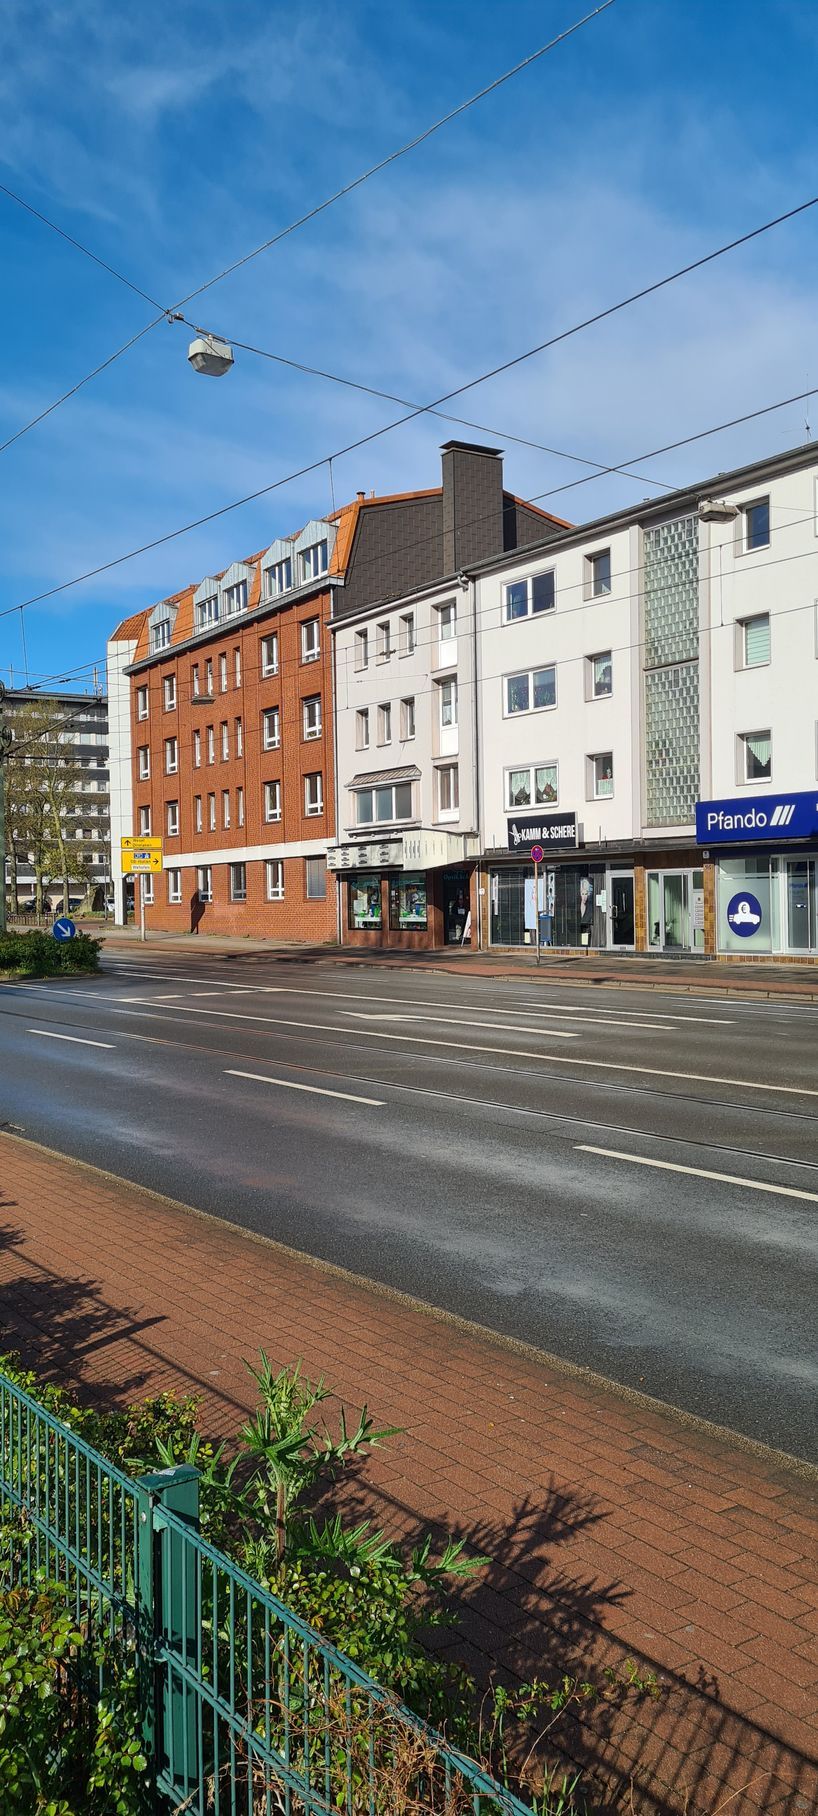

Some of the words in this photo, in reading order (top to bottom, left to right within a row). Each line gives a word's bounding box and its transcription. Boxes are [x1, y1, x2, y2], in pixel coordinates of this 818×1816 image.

[707, 808, 767, 831] Pfando
[521, 828, 541, 840] KAMM
[542, 827, 549, 839] &
[550, 825, 575, 839] SCHERE
